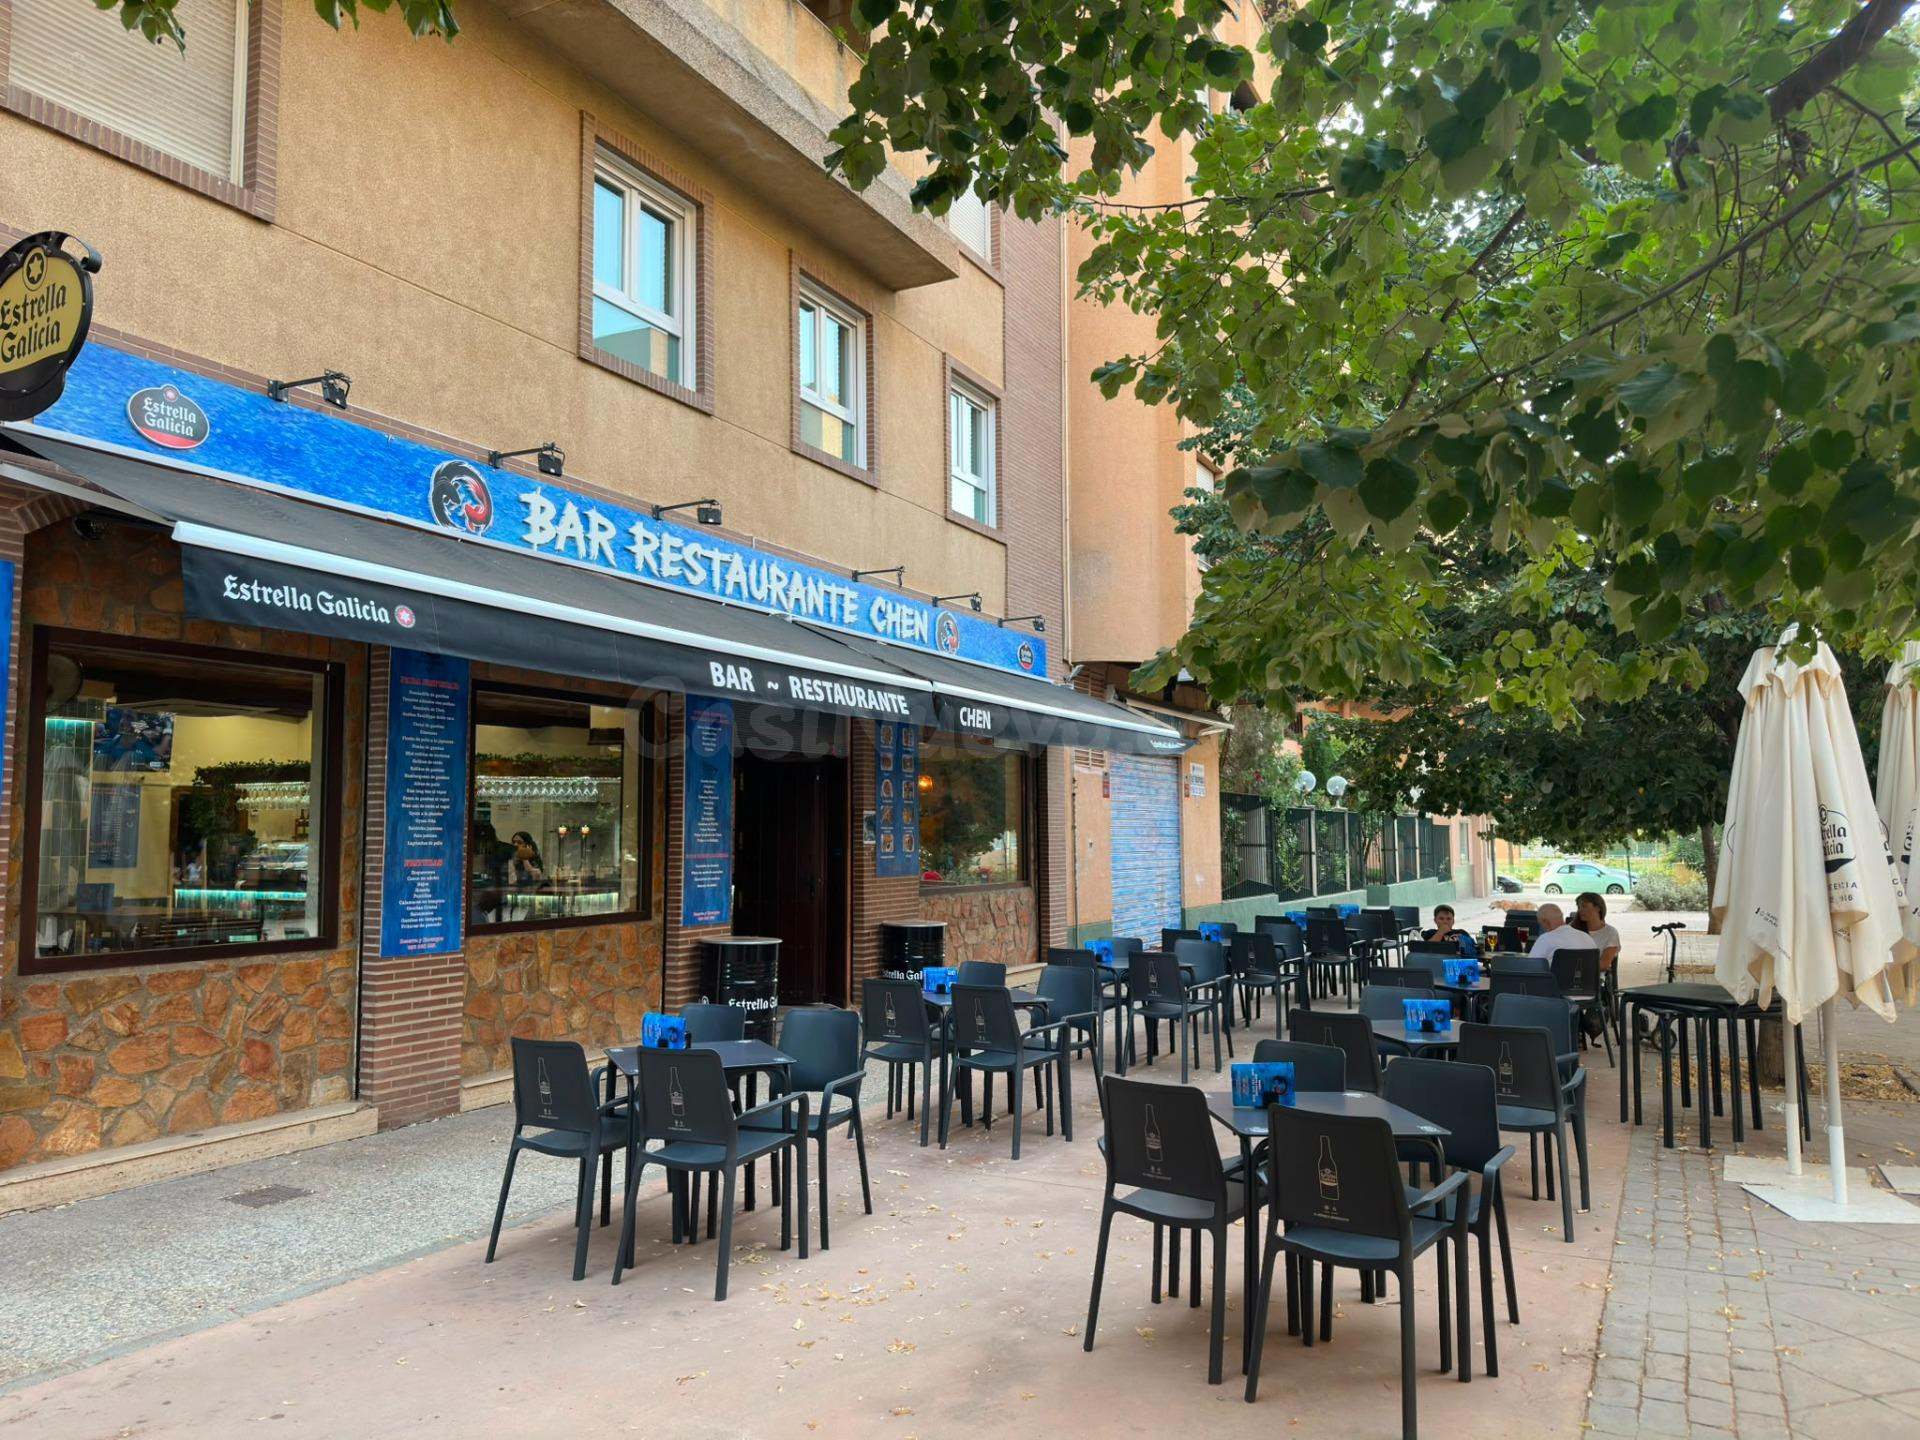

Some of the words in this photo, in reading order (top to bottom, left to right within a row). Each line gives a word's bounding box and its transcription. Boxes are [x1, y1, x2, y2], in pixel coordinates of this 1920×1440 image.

[0, 283, 67, 331] Estrella
[1, 316, 61, 363] Galicia
[143, 396, 197, 426] Estrella
[143, 410, 195, 438] Galicia
[518, 486, 617, 569] BAR
[625, 521, 859, 624] RESTAURANTE
[870, 596, 929, 643] CHEN
[223, 574, 313, 613] Estrella
[316, 591, 391, 624] Galicia
[709, 660, 756, 692] BAR
[789, 675, 911, 716] RESTAURANTE
[959, 706, 992, 730] CHEN
[728, 998, 769, 1011] Estrella
